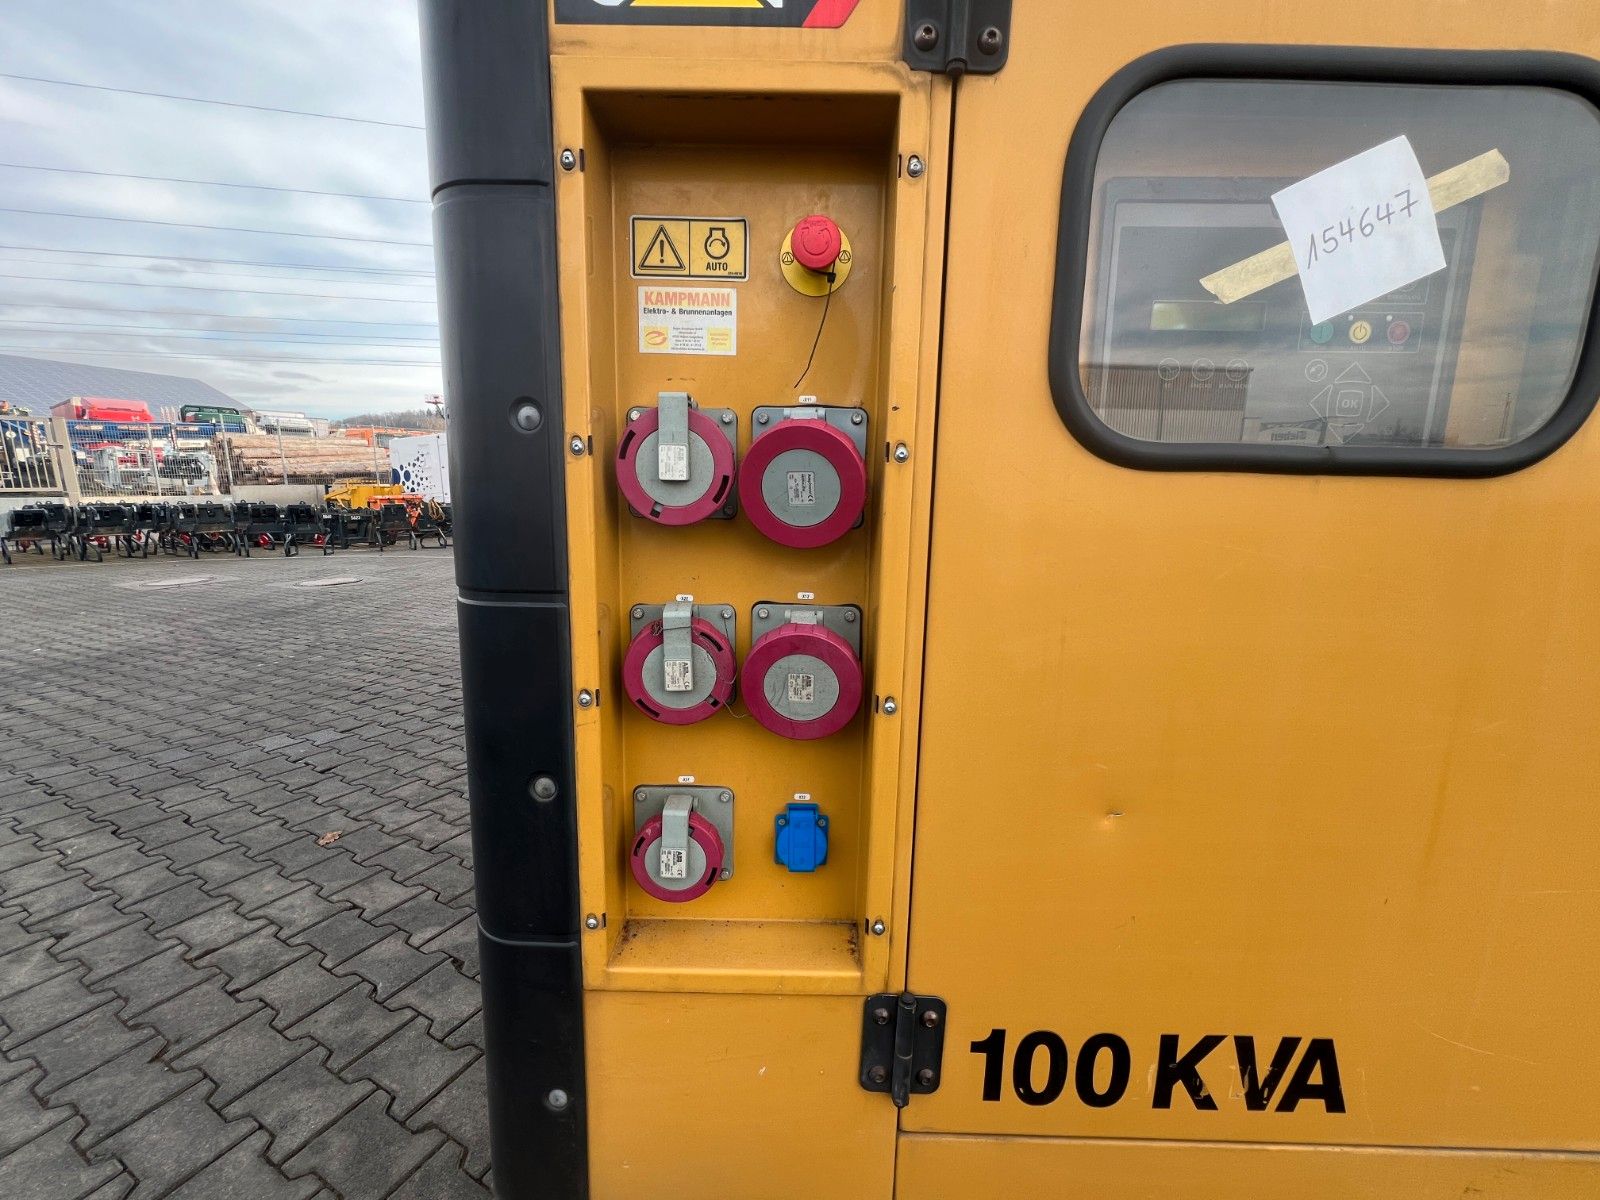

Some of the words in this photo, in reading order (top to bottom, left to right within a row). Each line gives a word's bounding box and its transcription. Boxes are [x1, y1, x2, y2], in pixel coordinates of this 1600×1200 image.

[1306, 188, 1419, 271] 154647
[705, 262, 728, 271] AUTO
[644, 291, 731, 307] KAMPMANN
[643, 307, 669, 315] Elektro-
[671, 307, 677, 315] &
[678, 308, 732, 317] Brunnenanlagen
[1341, 399, 1359, 409] OK
[675, 851, 683, 862] ABB
[969, 1028, 1131, 1107] 100
[1151, 1033, 1347, 1113] KVA
